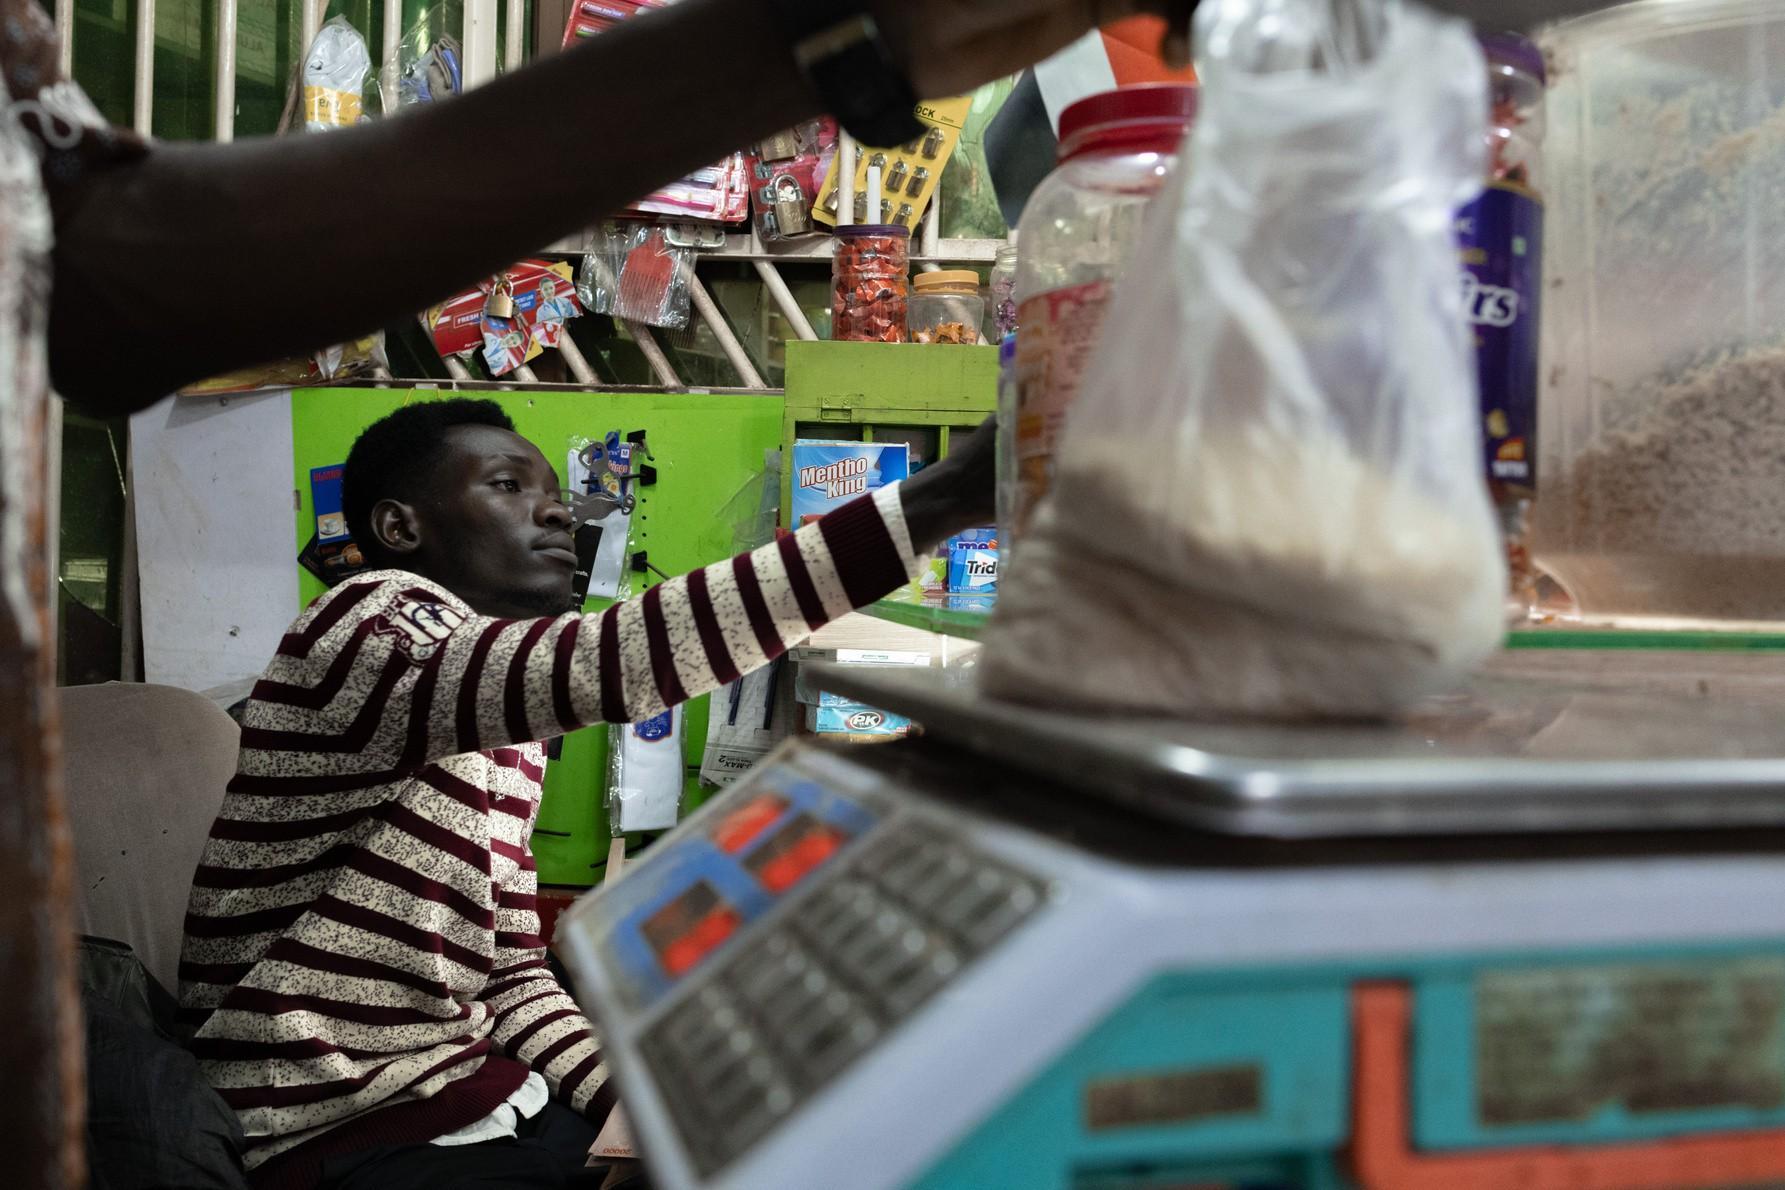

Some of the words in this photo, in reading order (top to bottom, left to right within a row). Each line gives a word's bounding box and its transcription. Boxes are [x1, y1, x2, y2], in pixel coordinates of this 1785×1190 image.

[914, 105, 936, 118] OCK
[800, 458, 867, 487] Mentho
[827, 476, 867, 499] King
[967, 560, 997, 575] Trid
